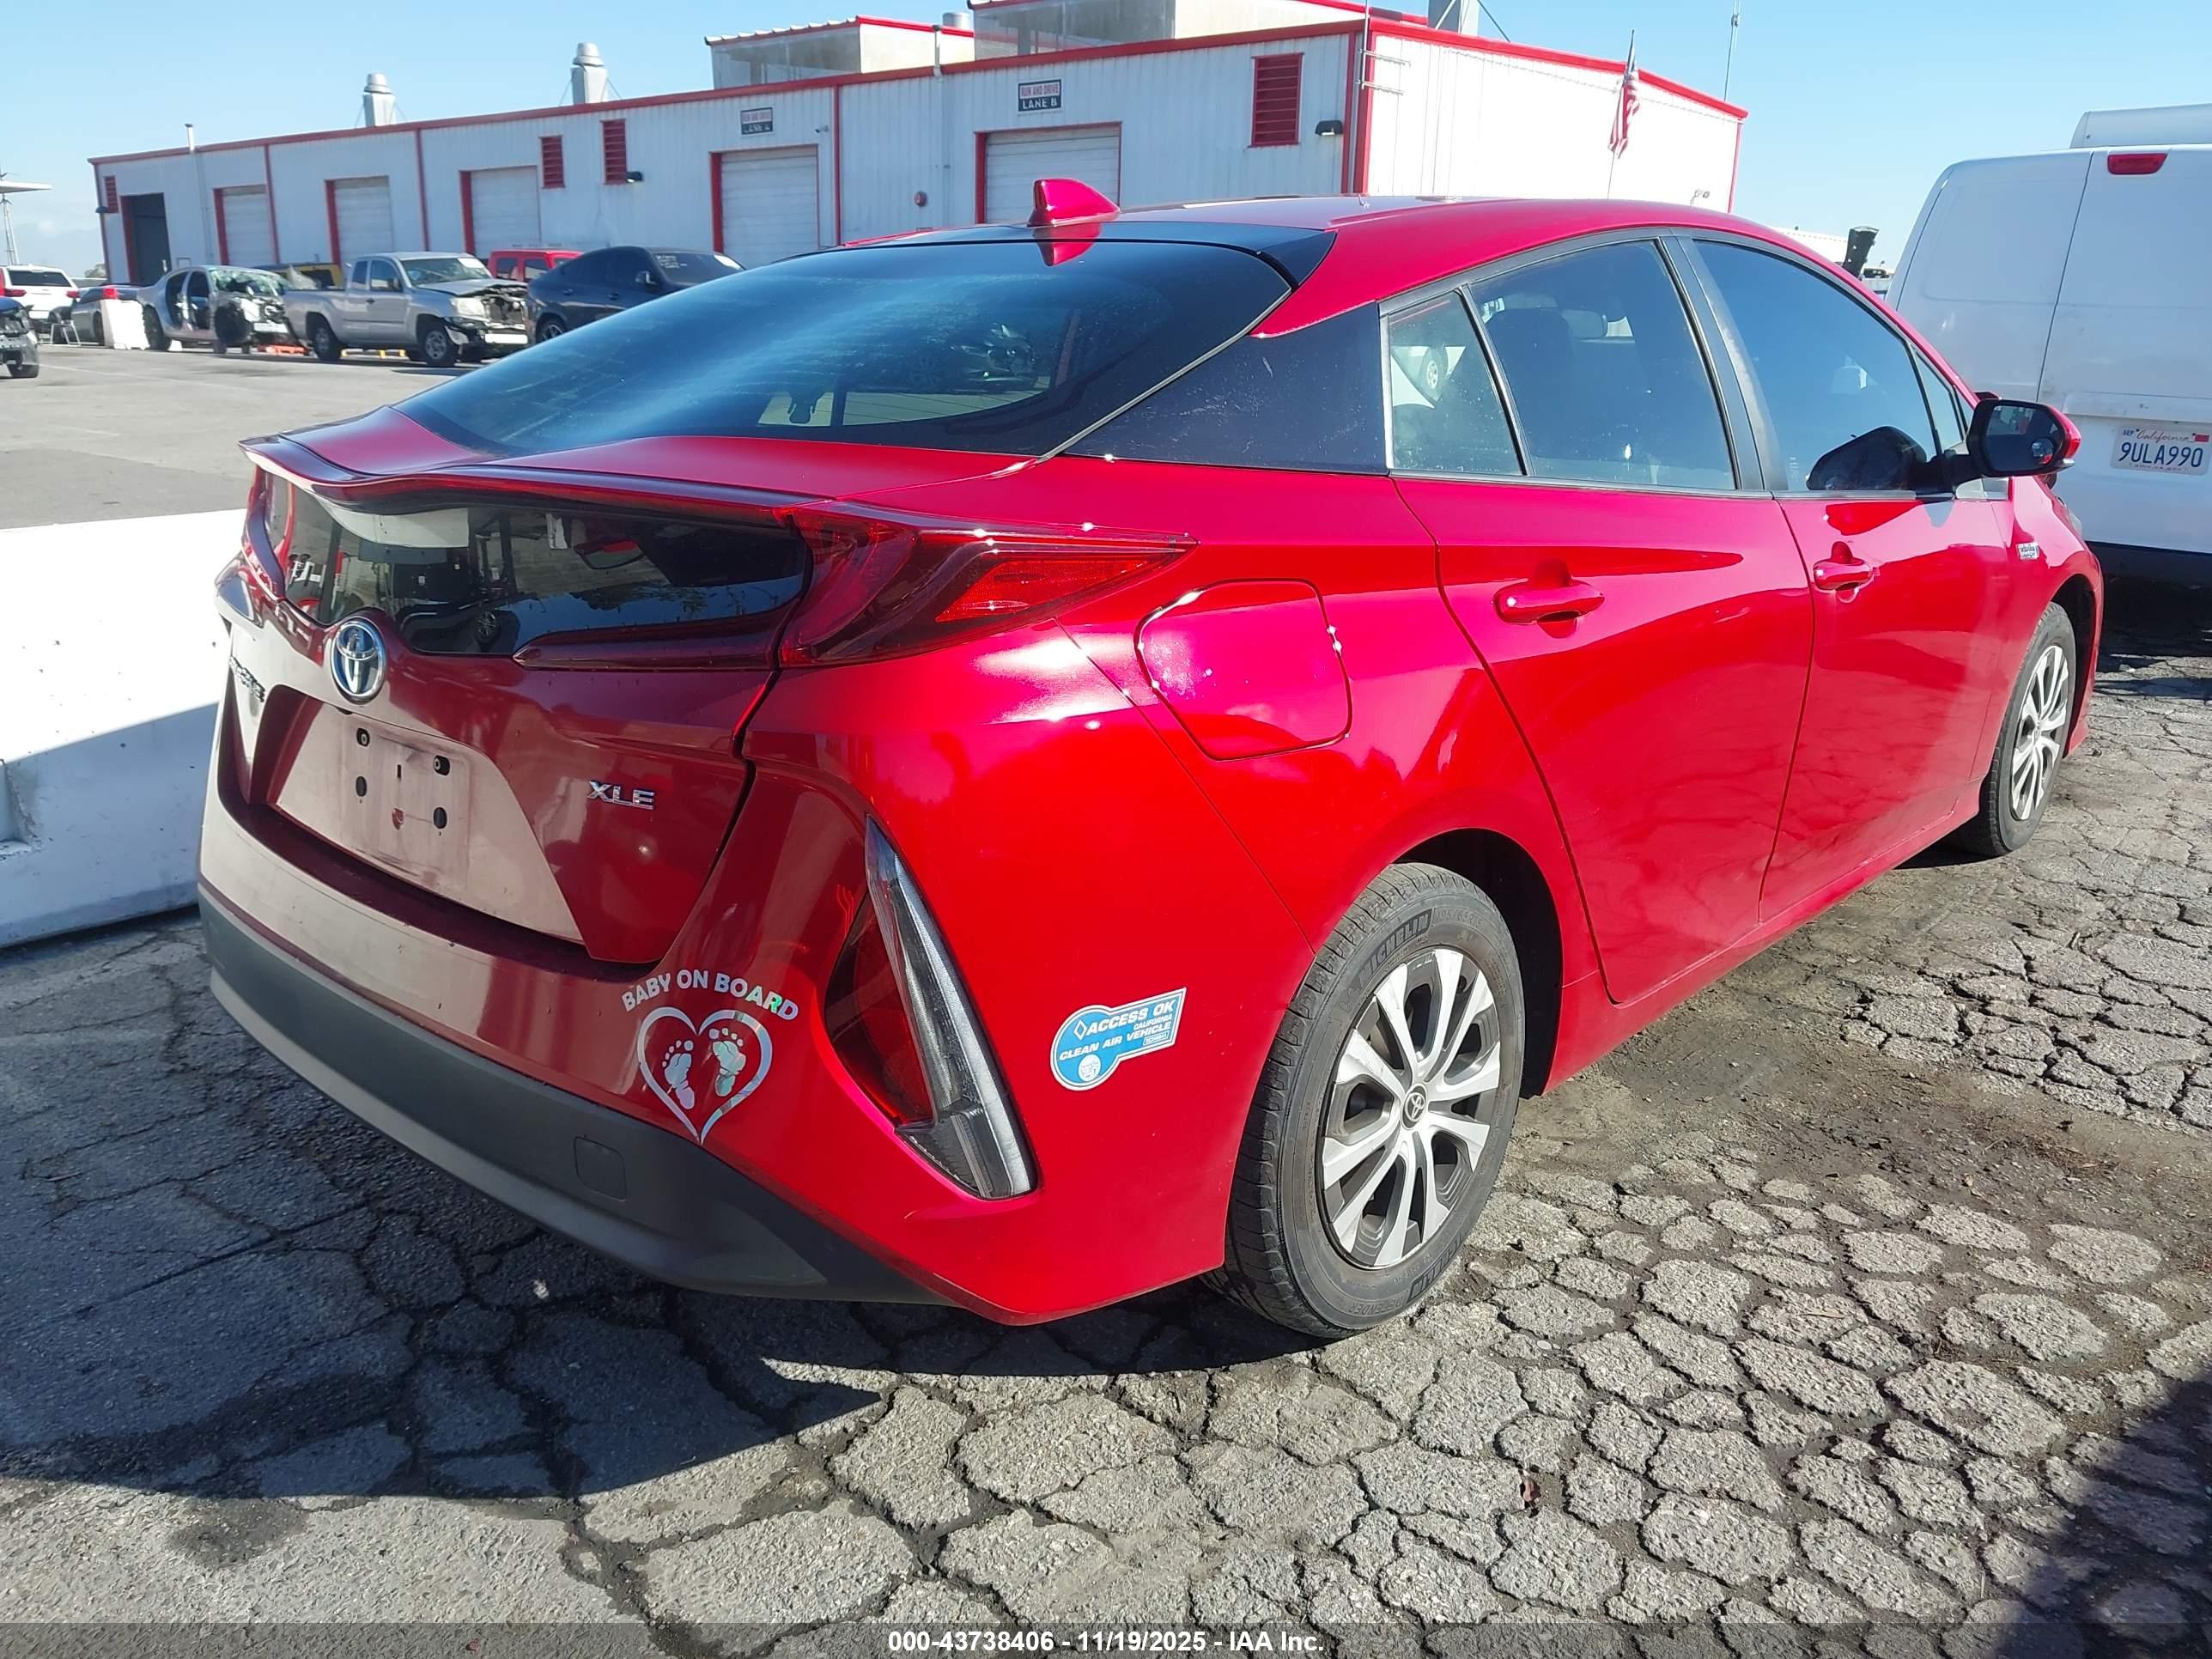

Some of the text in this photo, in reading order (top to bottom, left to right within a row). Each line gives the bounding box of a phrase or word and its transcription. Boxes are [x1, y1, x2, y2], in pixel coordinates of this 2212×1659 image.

[1023, 99, 1048, 109] LANE
[2136, 429, 2190, 444] California
[2118, 441, 2203, 468] 9ULA990
[586, 780, 655, 811] XLE
[1359, 913, 1430, 985] MICHELIN
[621, 969, 799, 1021] BABY ON BOARD
[1086, 999, 1176, 1036] ACCESS OK
[1133, 1013, 1173, 1031] CALIFORNIA
[1059, 1042, 1100, 1061] CLEAN
[1102, 1035, 1123, 1049] AIR
[1127, 1021, 1172, 1042] VEHICLE
